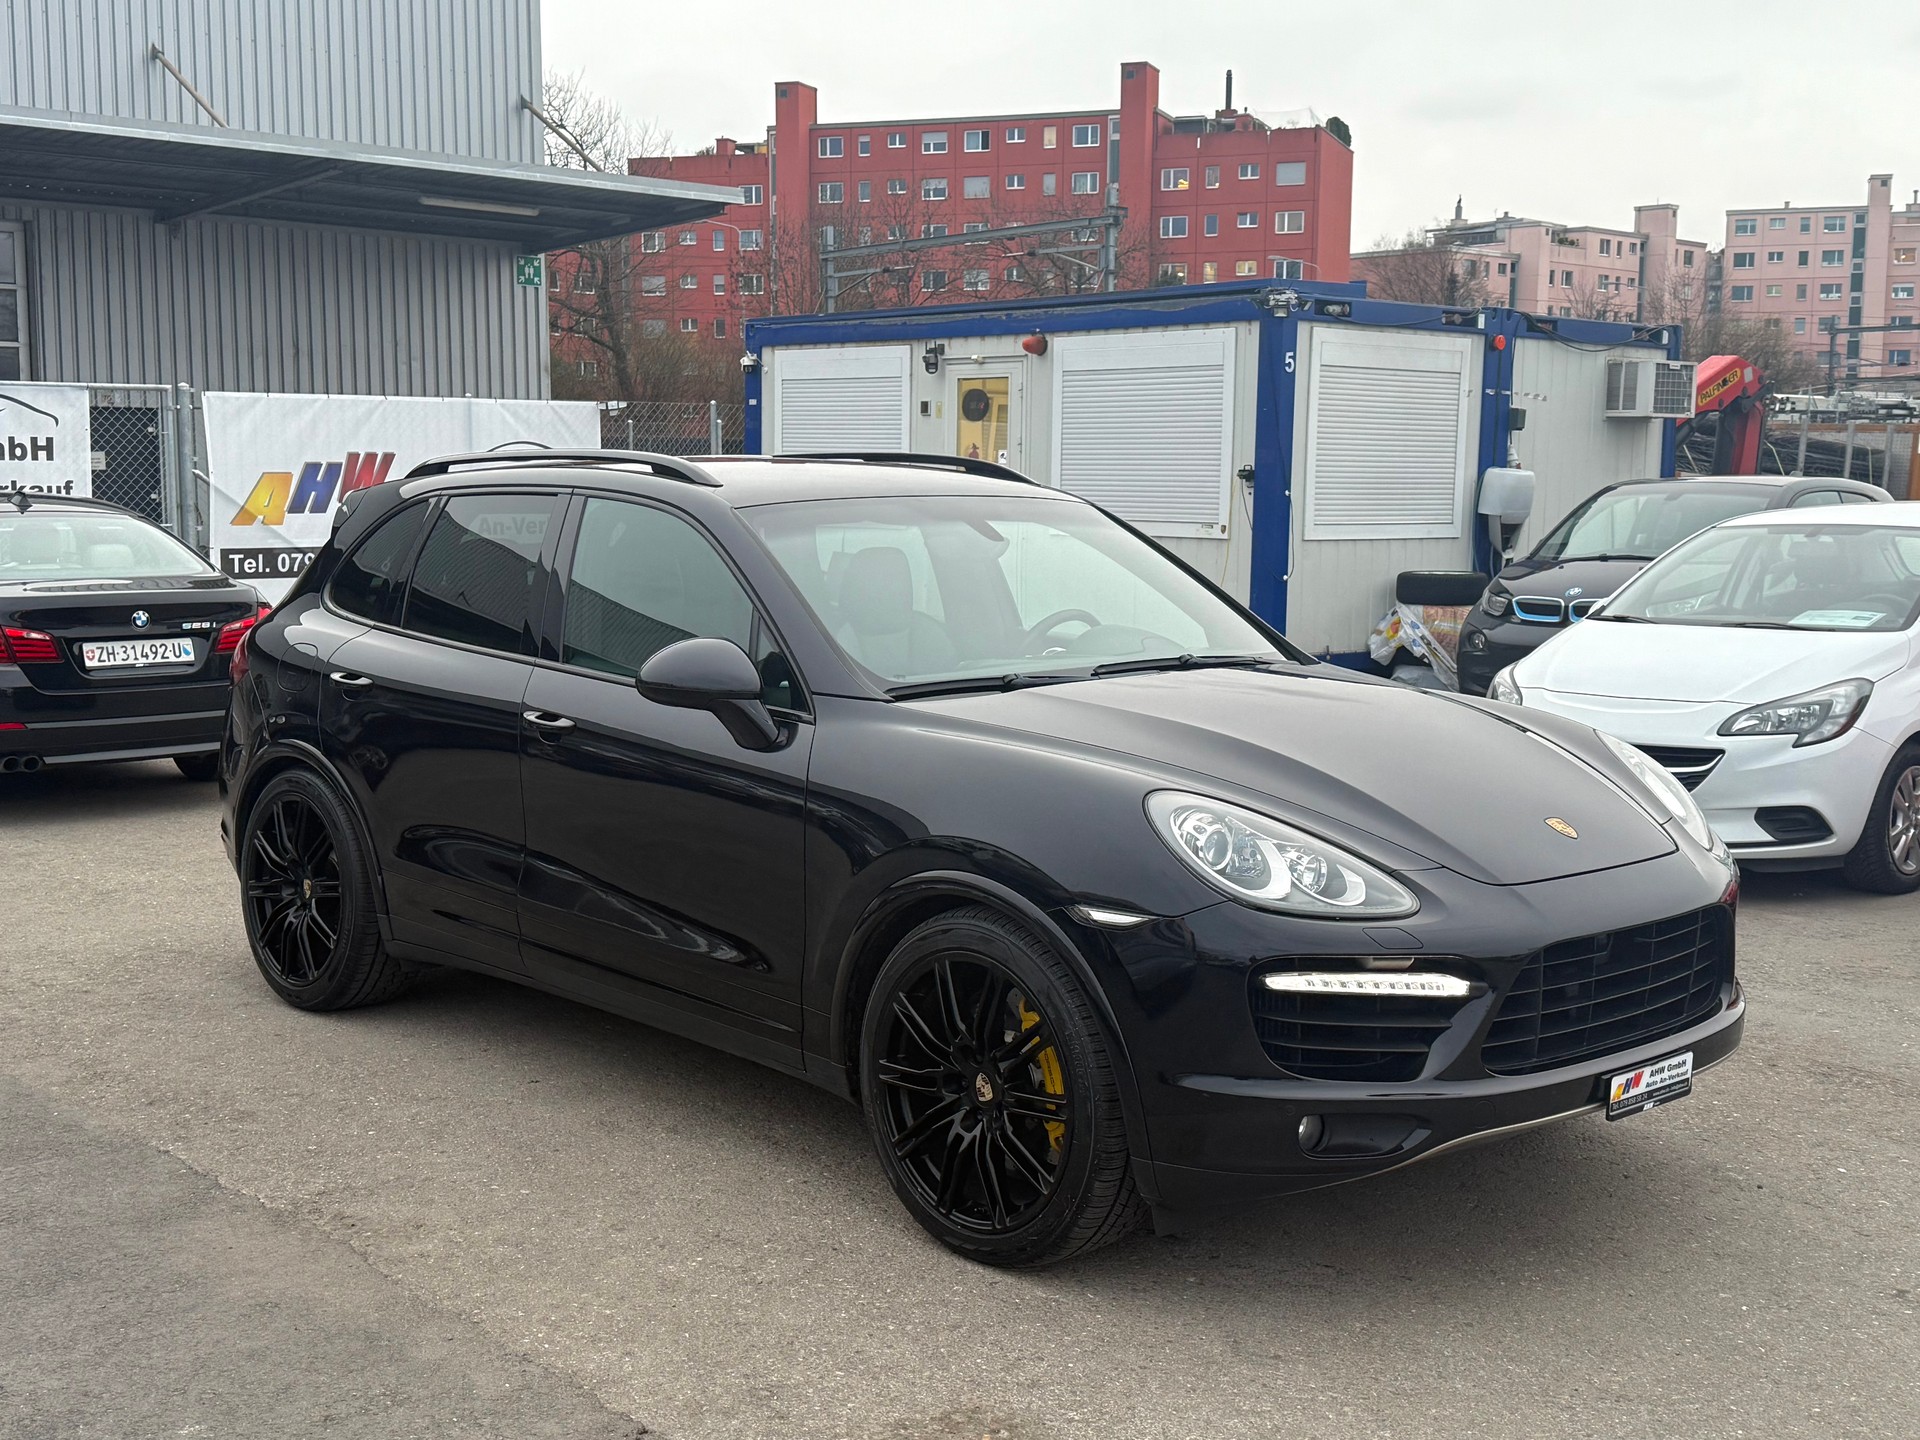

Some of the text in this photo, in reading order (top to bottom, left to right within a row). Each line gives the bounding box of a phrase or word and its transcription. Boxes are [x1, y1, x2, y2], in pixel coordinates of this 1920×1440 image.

[1285, 351, 1295, 373] 5
[1700, 370, 1739, 403] PALFINER
[0, 436, 54, 461] bH
[230, 451, 396, 526] AHW
[479, 515, 550, 535] An-Ver
[229, 554, 271, 574] Tel.
[1645, 1069, 1689, 1088] Auto An-Verkauf
[1649, 1059, 1687, 1078] AHW GmbH
[1612, 1070, 1645, 1101] AHW
